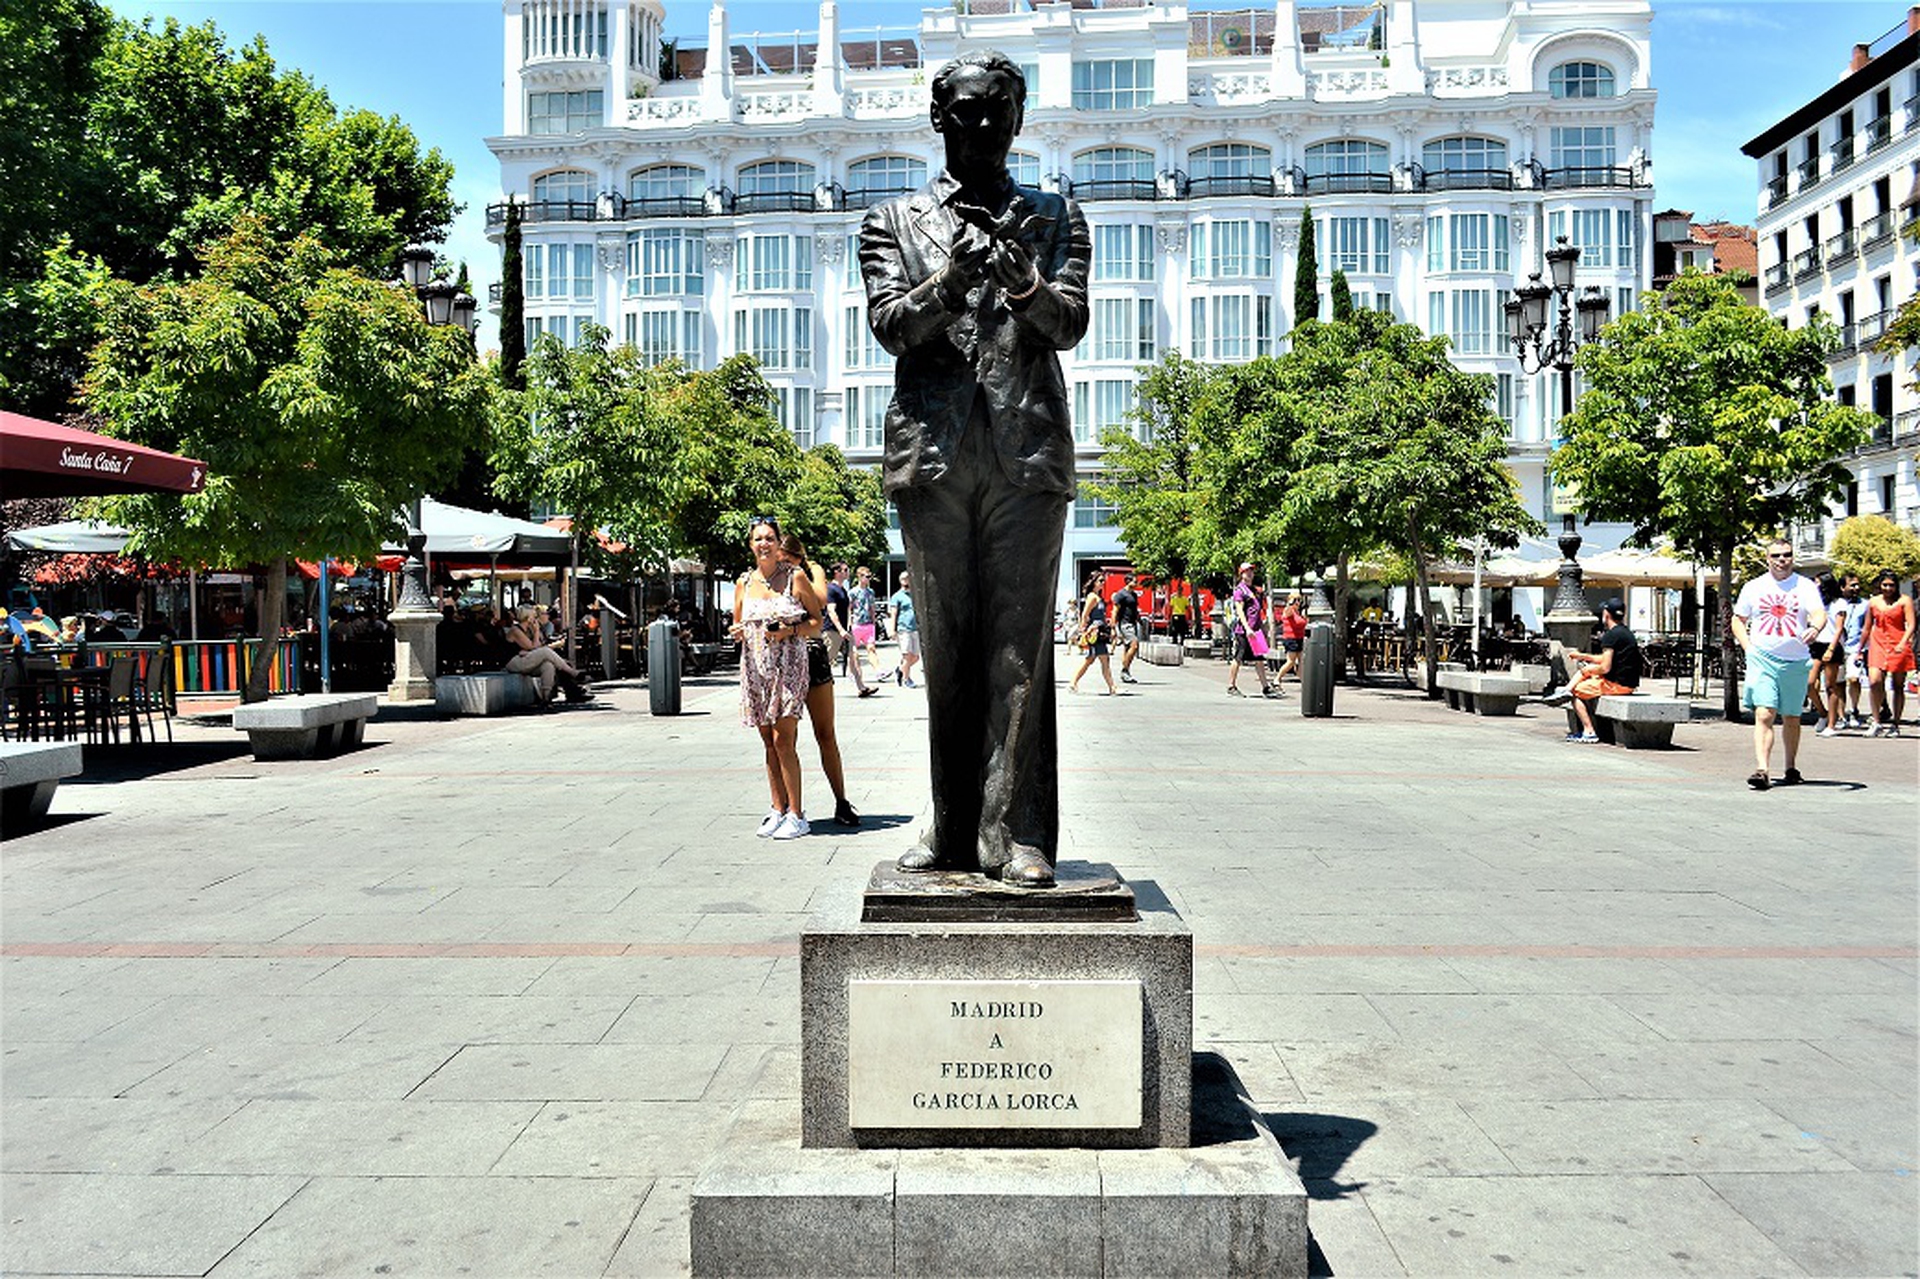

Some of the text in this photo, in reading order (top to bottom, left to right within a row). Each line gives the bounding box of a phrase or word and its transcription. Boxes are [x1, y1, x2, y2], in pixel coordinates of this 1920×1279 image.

[60, 446, 92, 469] Santa
[122, 455, 134, 474] 7
[950, 1001, 1044, 1018] MADRID
[989, 1033, 1004, 1049] A
[940, 1062, 1052, 1080] FEDERICO
[912, 1092, 1079, 1110] GARCIA LORCA
